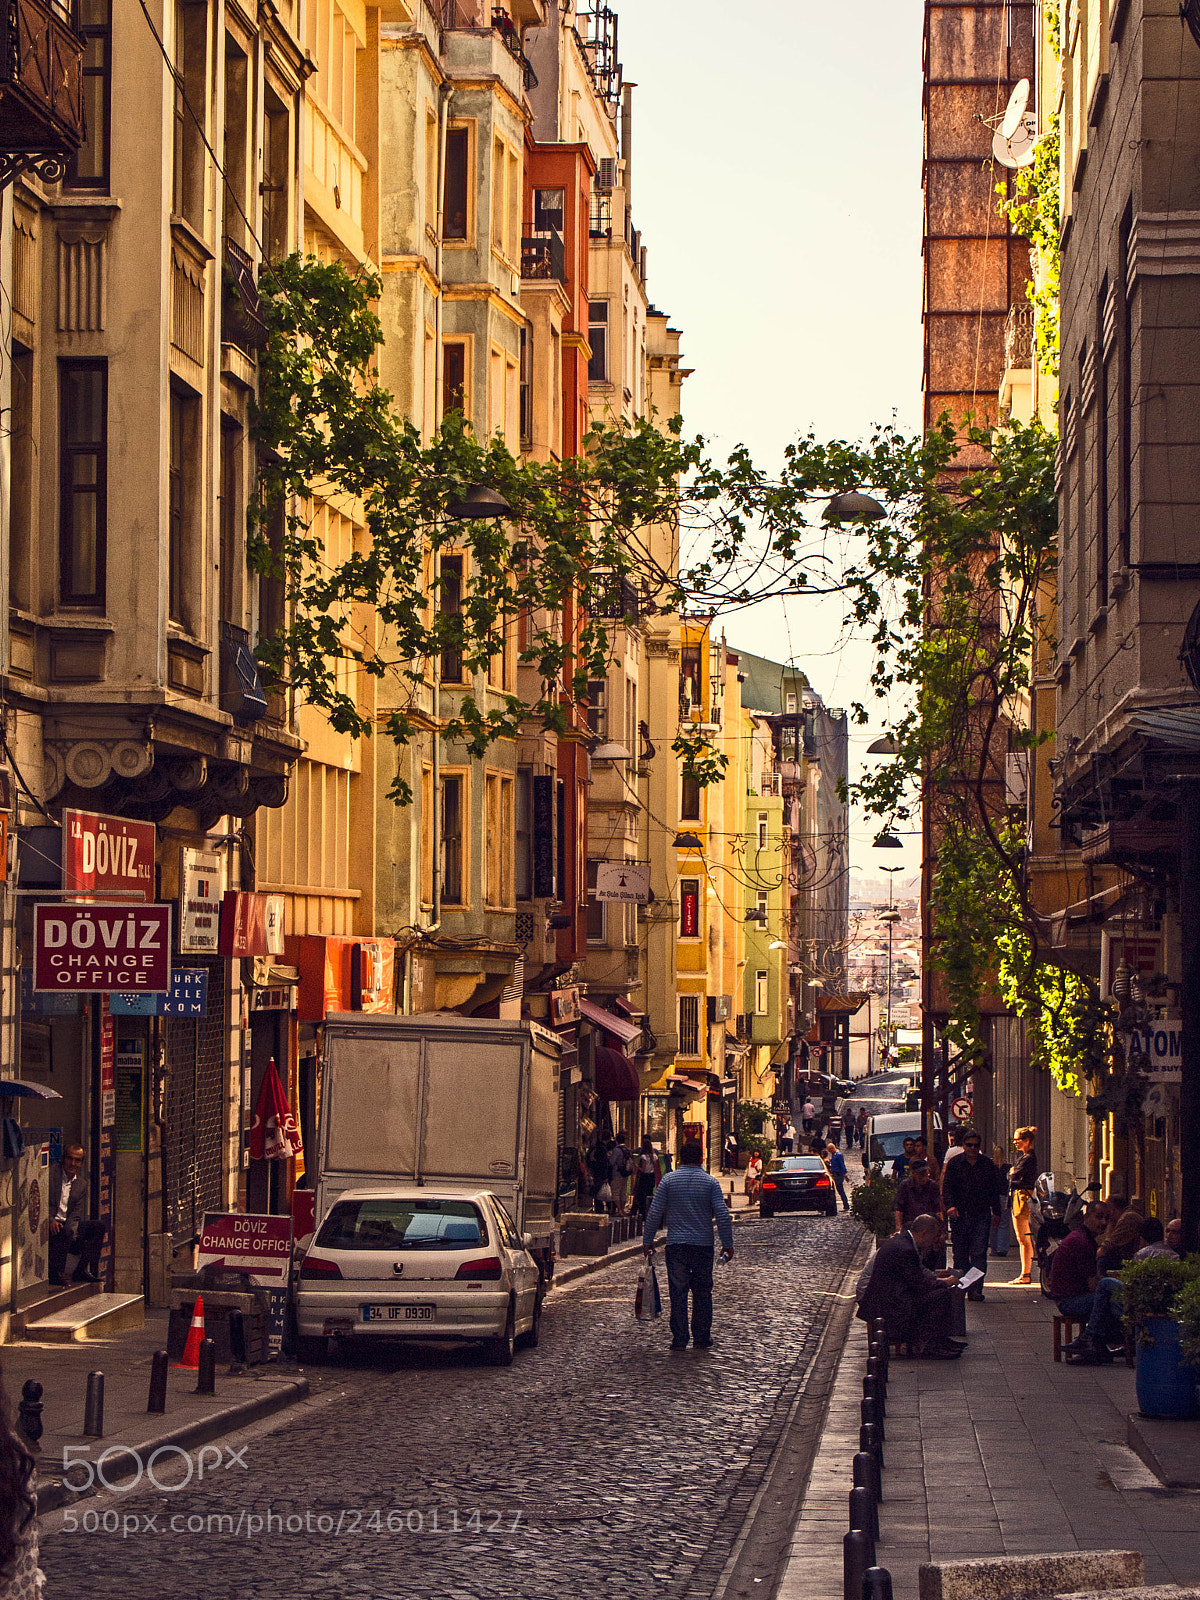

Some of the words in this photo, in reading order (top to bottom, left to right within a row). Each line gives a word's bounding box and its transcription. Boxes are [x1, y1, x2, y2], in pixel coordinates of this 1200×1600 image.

[83, 822, 138, 878] DÖVİZ
[44, 912, 160, 949] DÖVİZ
[50, 954, 154, 967] CHANGE
[56, 971, 147, 984] OFFICE
[174, 974, 202, 984] ÜRK
[163, 1002, 201, 1013] KOM
[117, 1057, 142, 1065] matbaa
[234, 1218, 268, 1234] DÖVİZ
[202, 1236, 250, 1250] CHANGE
[252, 1239, 291, 1252] OFFICE
[370, 1307, 382, 1319] 34
[388, 1307, 401, 1319] UF
[405, 1307, 431, 1319] 0930
